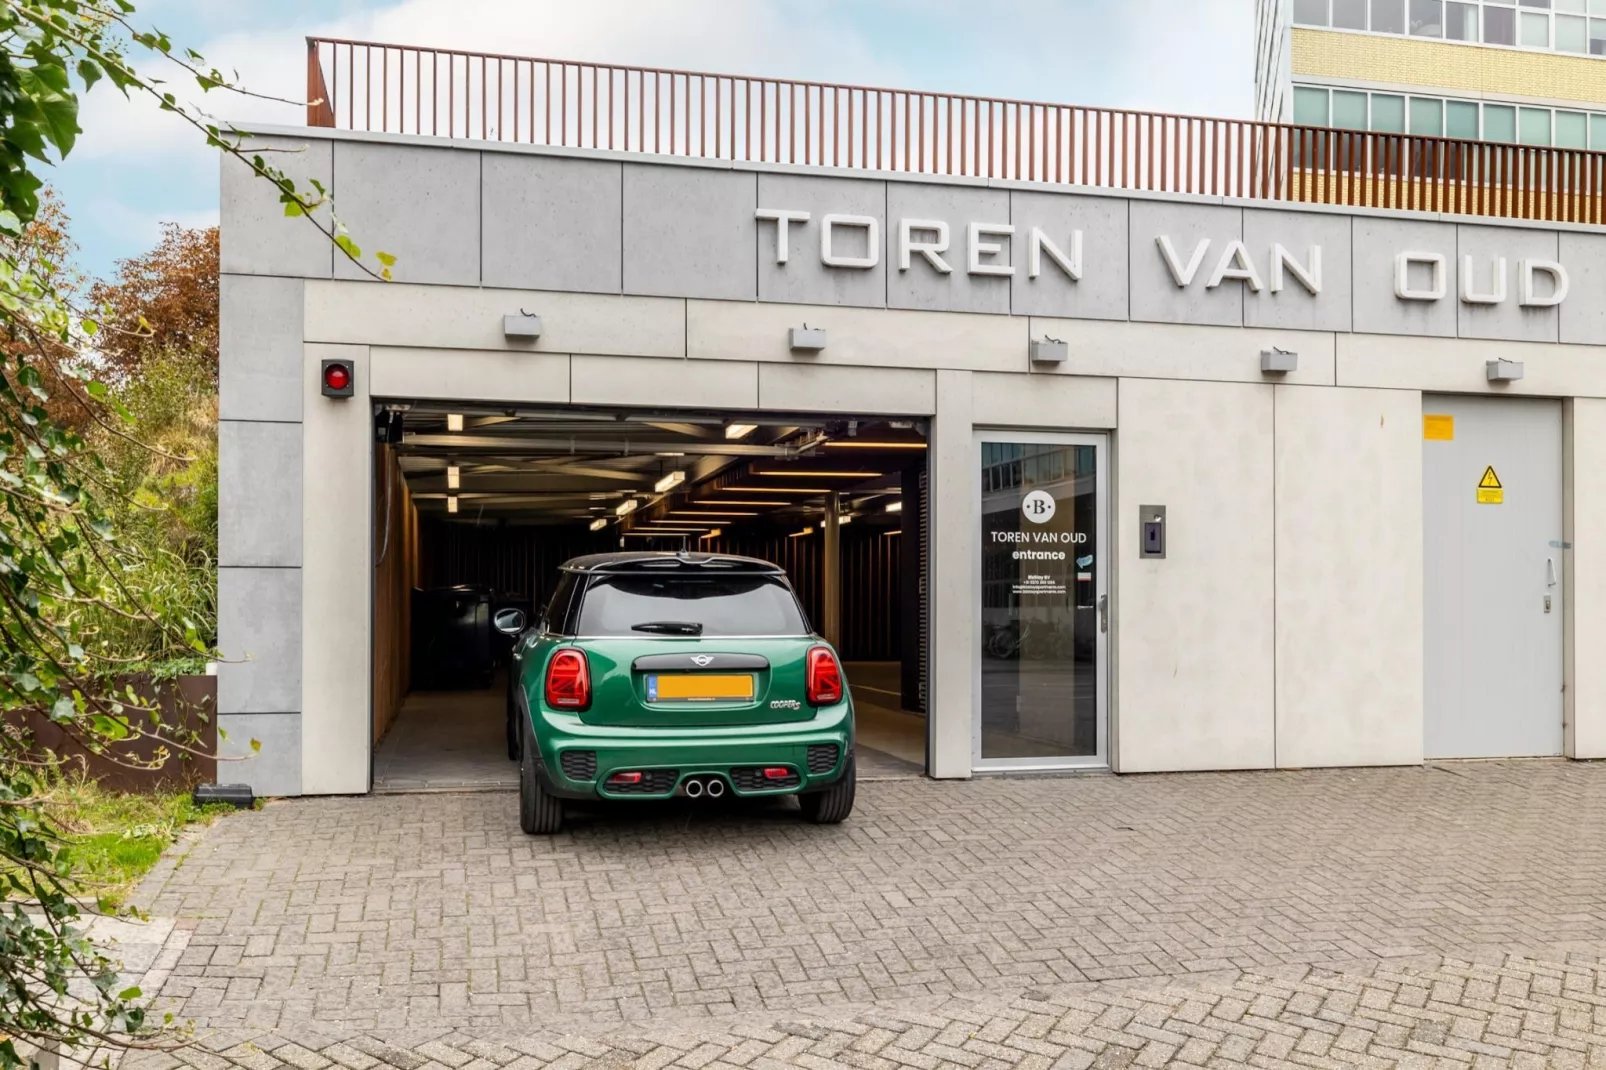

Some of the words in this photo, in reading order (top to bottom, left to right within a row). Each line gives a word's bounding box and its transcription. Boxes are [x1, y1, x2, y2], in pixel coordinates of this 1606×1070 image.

[755, 208, 1083, 282] TOREN
[1155, 234, 1323, 296] VAN
[1394, 251, 1570, 308] OUD
[991, 531, 1030, 543] TOREN
[1032, 532, 1058, 543] VAN
[1060, 532, 1087, 543] OUD
[1012, 550, 1066, 560] entrance
